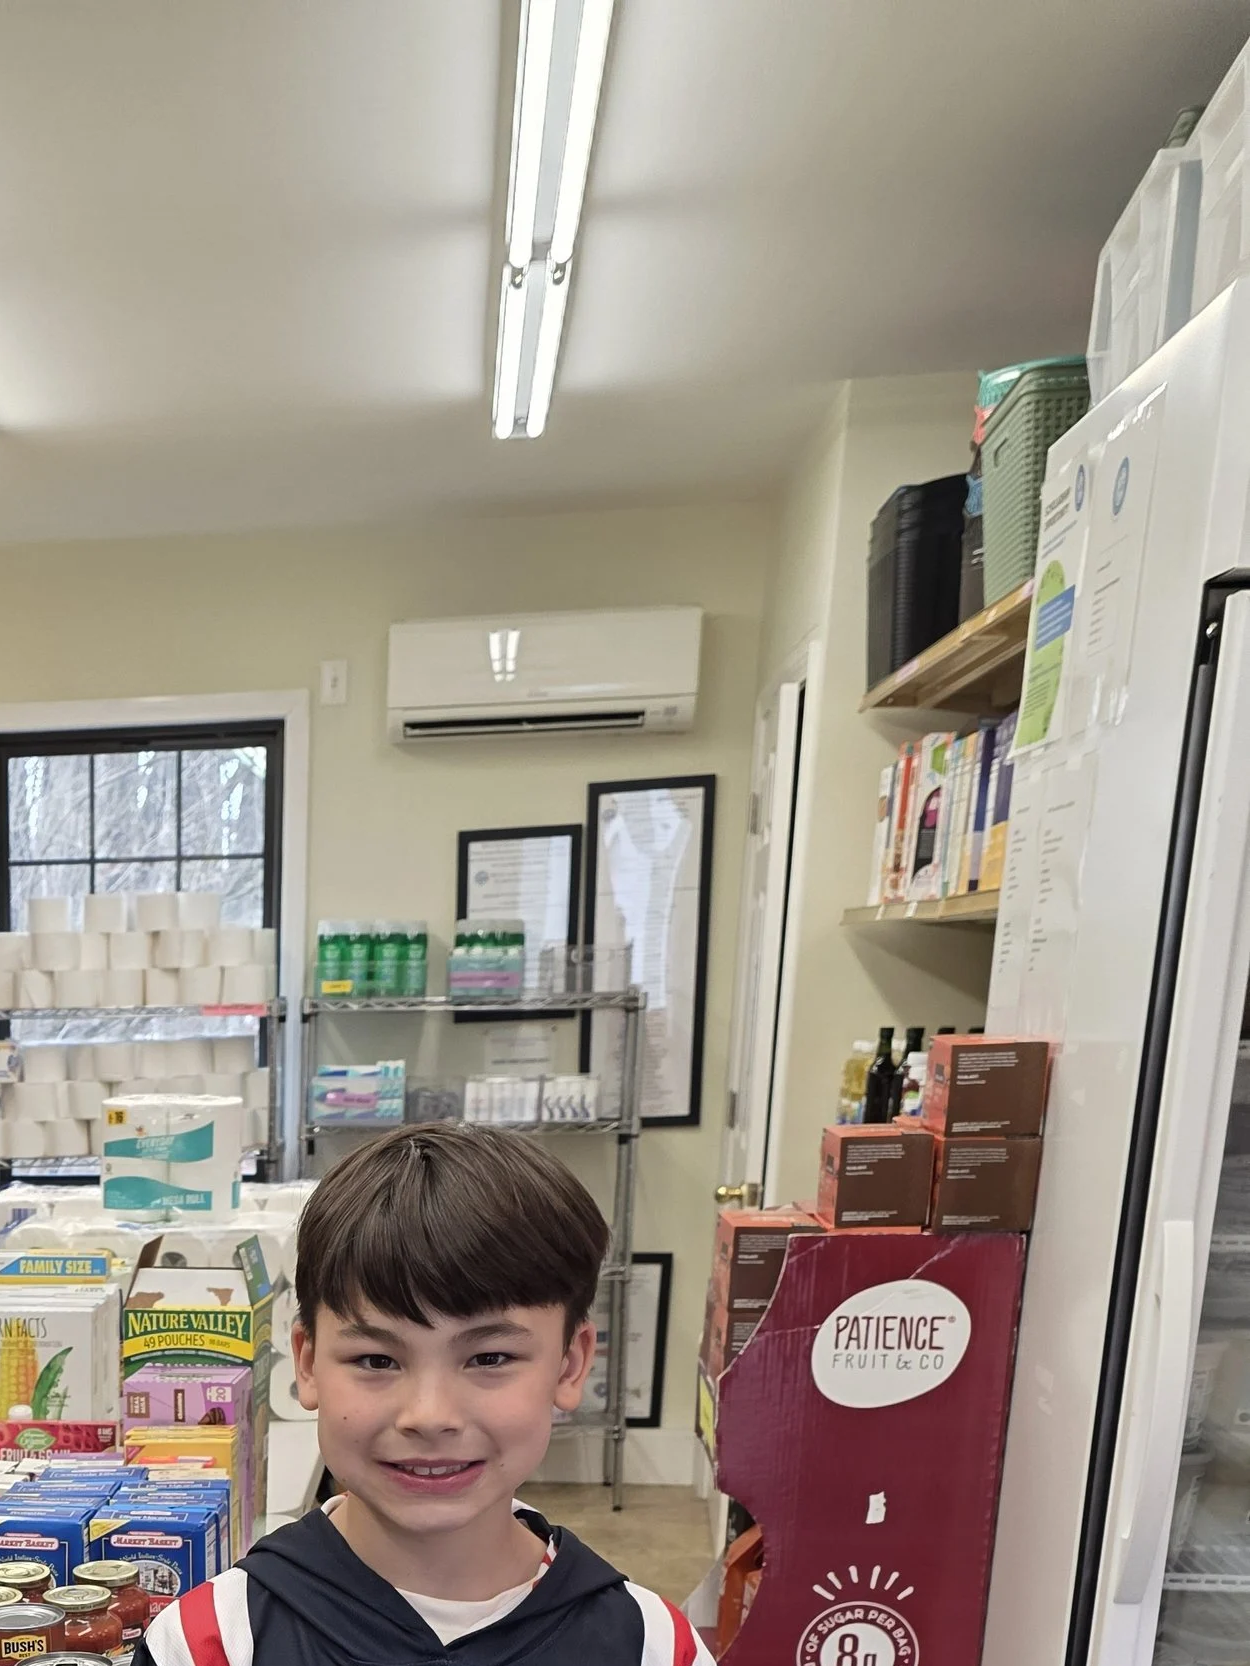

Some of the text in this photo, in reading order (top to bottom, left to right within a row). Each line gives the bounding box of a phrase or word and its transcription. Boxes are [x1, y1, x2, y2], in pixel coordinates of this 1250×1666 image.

[19, 1259, 93, 1275] FAMILY SIZE
[16, 1317, 48, 1339] FACTS
[128, 1312, 247, 1339] NATURE VALLEY
[834, 1315, 947, 1351] PATIENCE
[144, 1334, 206, 1349] 49 POUCHES
[832, 1353, 944, 1370] FRUIT & CO
[24, 1538, 56, 1548] BASKET
[113, 1536, 180, 1547] MARKET BASKET
[805, 1608, 911, 1657] OF SUGAR PER BAG
[4, 1638, 45, 1654] BUSH'S
